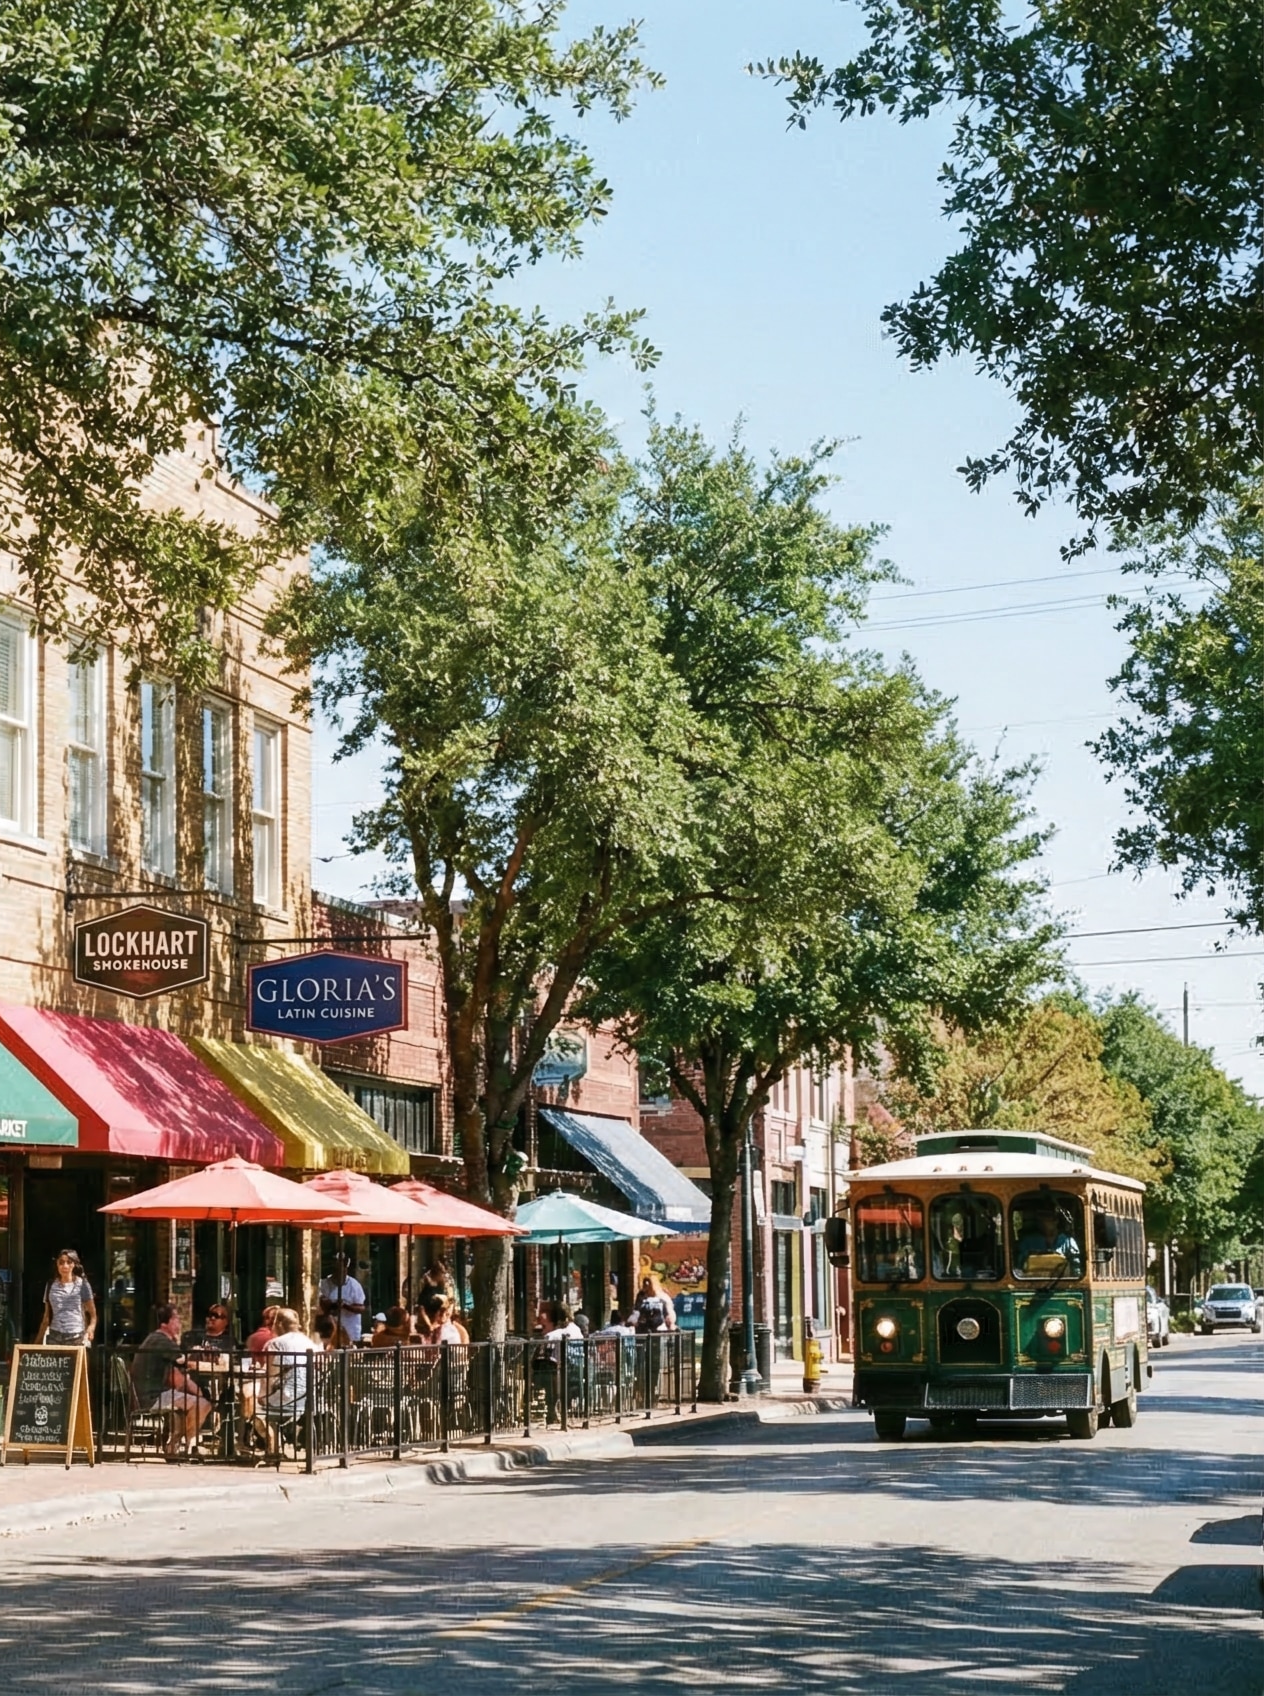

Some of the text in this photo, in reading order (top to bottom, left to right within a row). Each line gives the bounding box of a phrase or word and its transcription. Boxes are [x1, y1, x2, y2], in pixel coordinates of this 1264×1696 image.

[85, 930, 198, 957] LOCKHART
[93, 958, 188, 971] SMOKEHOUSE
[257, 974, 396, 1003] GLORIA'S
[278, 1007, 375, 1019] LATIN CUISINE
